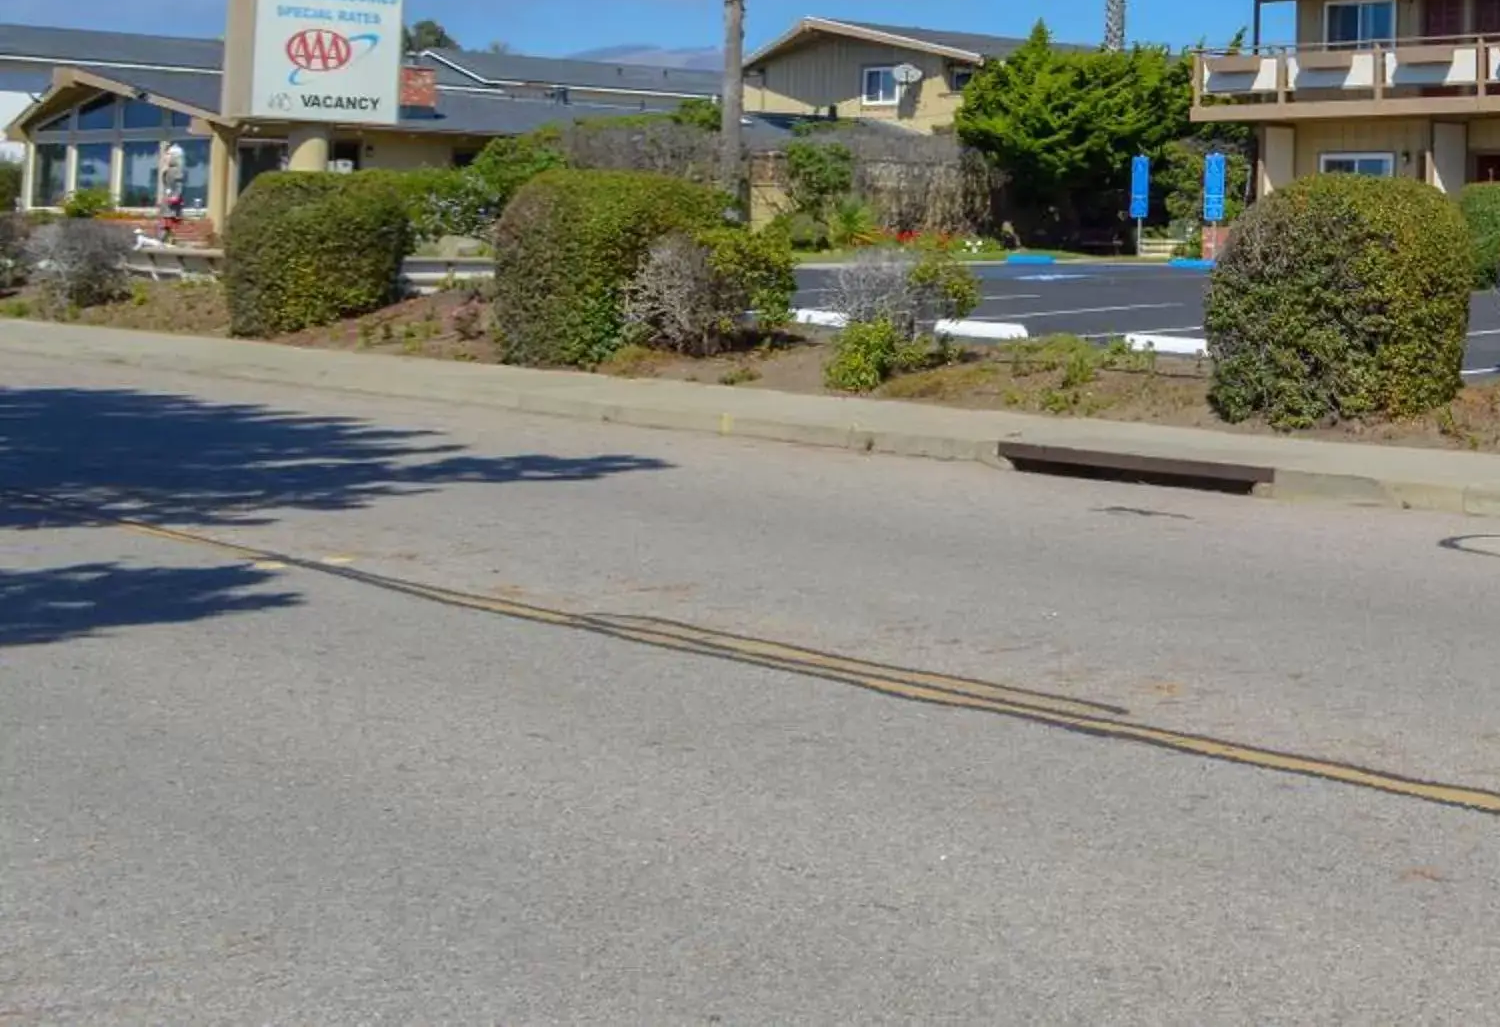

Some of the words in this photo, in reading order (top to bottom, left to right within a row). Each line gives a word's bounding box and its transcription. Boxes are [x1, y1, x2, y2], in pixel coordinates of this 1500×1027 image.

[277, 5, 333, 20] SPECIAL
[338, 10, 382, 24] RATES
[288, 29, 350, 71] AAA
[301, 94, 381, 111] VACANCY
